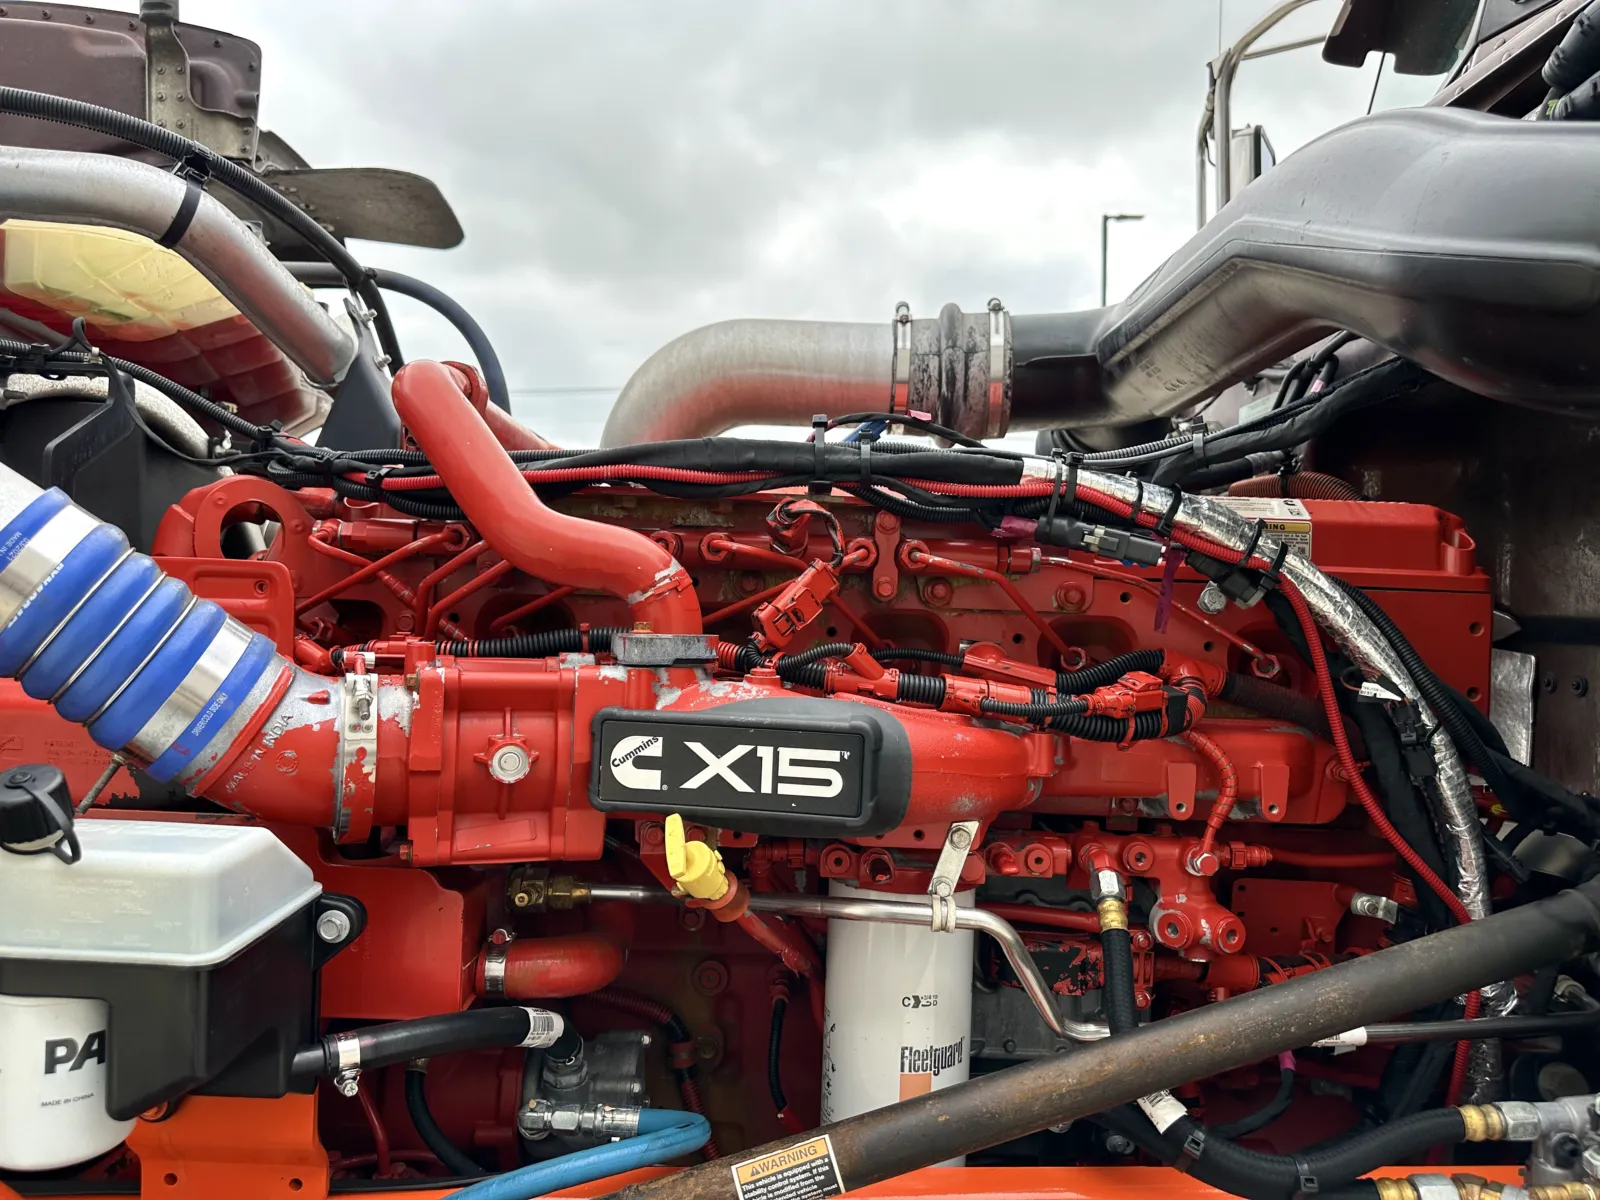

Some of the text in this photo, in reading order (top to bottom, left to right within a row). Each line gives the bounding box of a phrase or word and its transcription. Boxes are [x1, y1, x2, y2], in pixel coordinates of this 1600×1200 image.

[5, 531, 22, 548] MADE
[1262, 523, 1286, 531] NING
[208, 701, 221, 713] SIDE
[216, 691, 229, 705] ONLY
[261, 714, 294, 750] INDIA
[611, 736, 659, 768] Cummins
[679, 741, 843, 798] X15
[44, 1029, 106, 1075] PA
[900, 1036, 963, 1076] Fleetguard
[41, 1099, 61, 1107] MADE
[73, 1092, 94, 1102] CHINA
[758, 1145, 817, 1172] WARNING
[742, 1183, 755, 1191] This
[755, 1176, 776, 1187] vehicle
[783, 1163, 810, 1177] equipped
[811, 1159, 824, 1167] with
[744, 1187, 767, 1199] stability
[768, 1179, 789, 1190] control
[789, 1171, 812, 1183] system.
[774, 1182, 799, 1196] modified
[800, 1179, 814, 1187] from
[823, 1183, 838, 1192] must
[797, 1184, 817, 1195] vehicle
